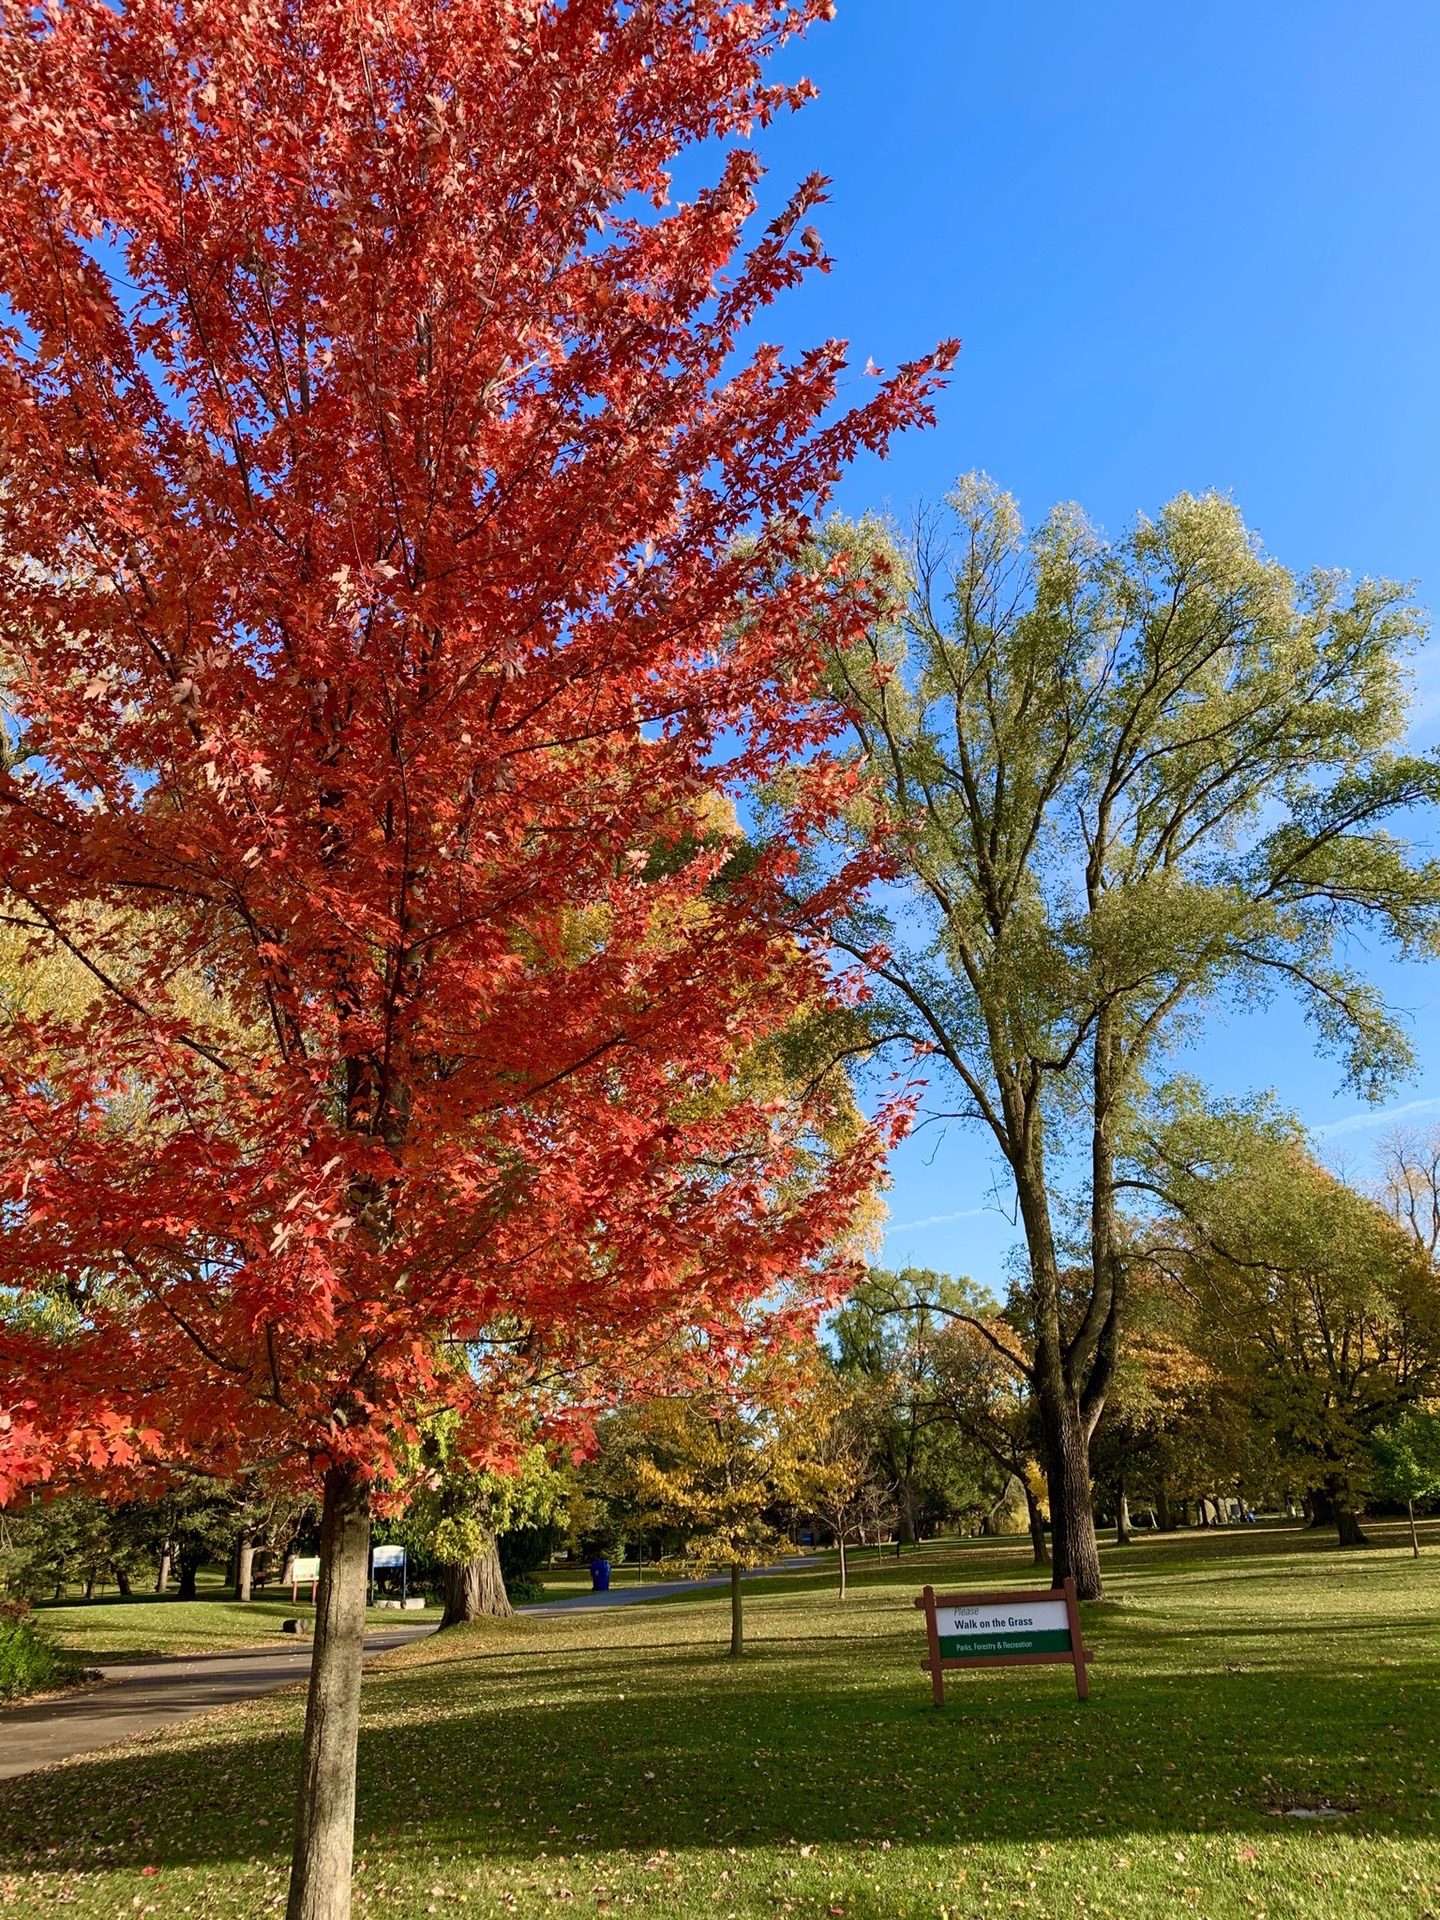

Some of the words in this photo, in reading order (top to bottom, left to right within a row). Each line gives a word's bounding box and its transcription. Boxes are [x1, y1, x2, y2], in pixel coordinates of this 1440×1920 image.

[953, 1607, 980, 1616] Please
[954, 1620, 978, 1630] Walk
[979, 1620, 990, 1628] on
[992, 1618, 1006, 1628] the
[1008, 1617, 1033, 1627] Grass
[974, 1642, 996, 1650] Forestry
[997, 1642, 1002, 1650] &
[1003, 1641, 1033, 1649] Recreation
